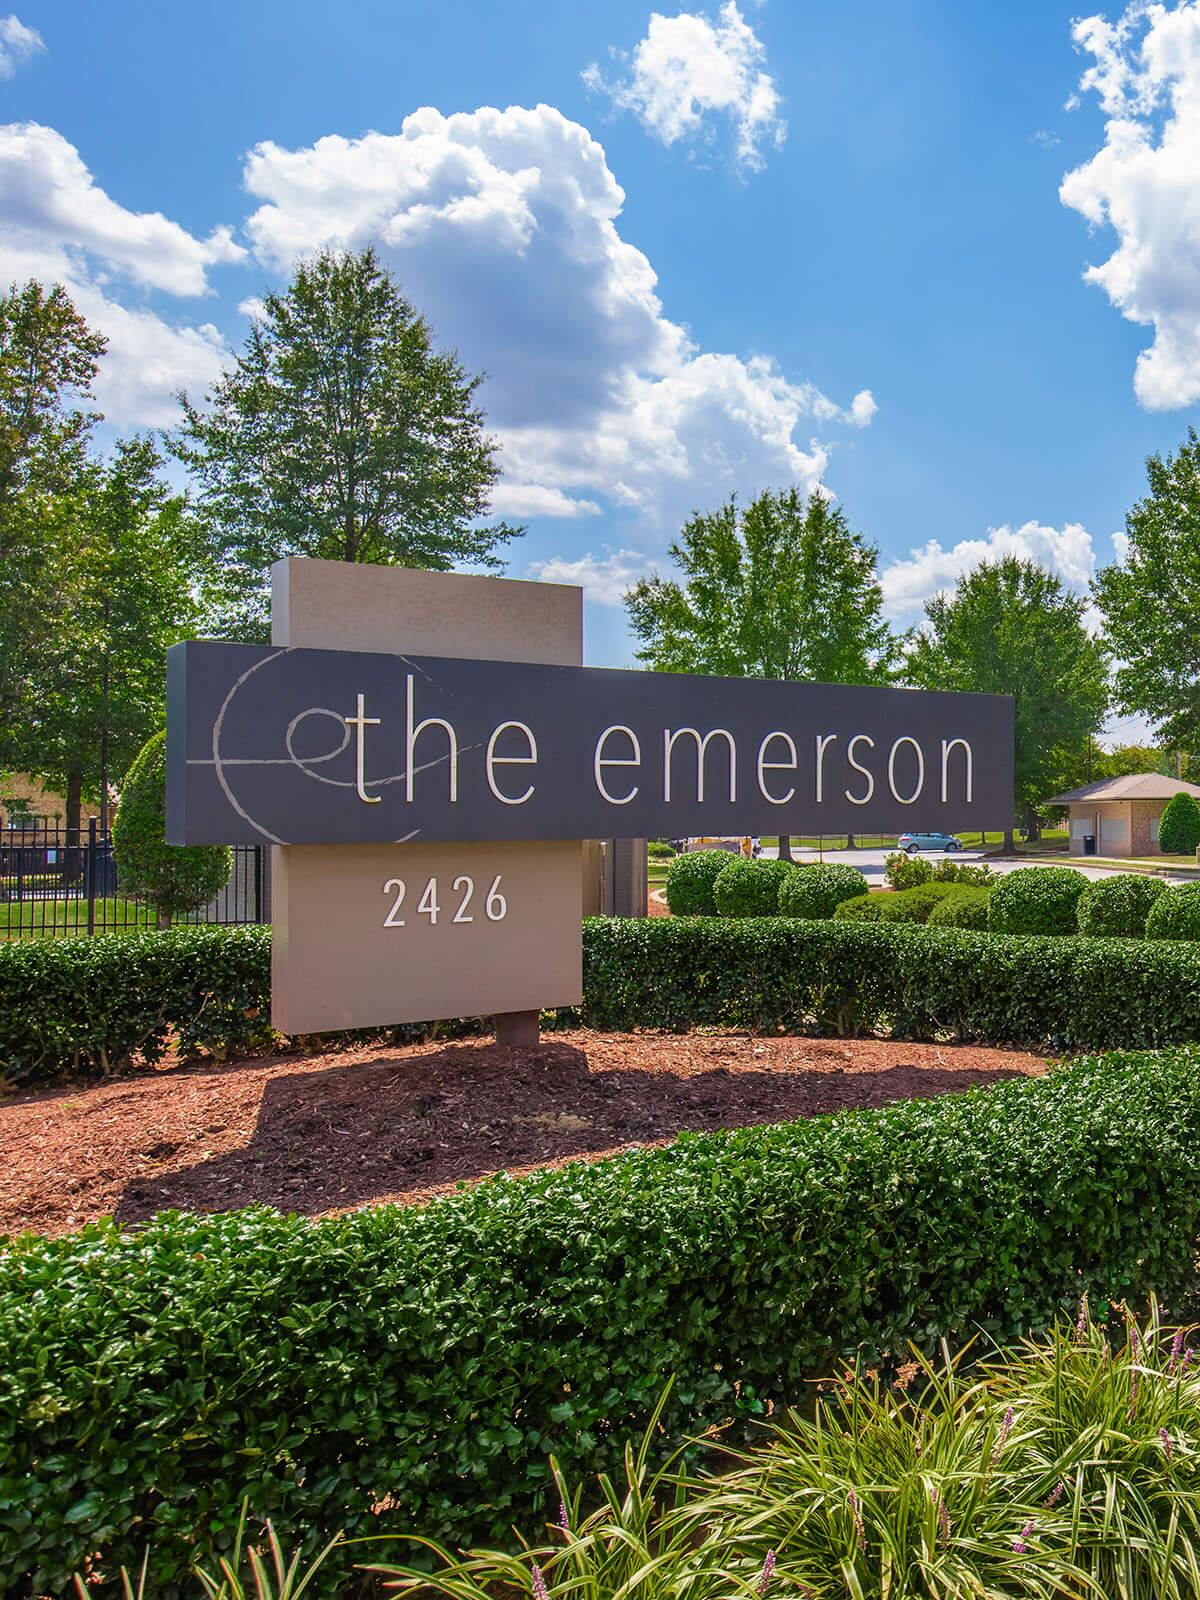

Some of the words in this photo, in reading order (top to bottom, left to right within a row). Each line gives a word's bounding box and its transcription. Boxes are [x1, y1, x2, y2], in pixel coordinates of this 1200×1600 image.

[345, 674, 538, 805] the
[593, 724, 975, 805] emerson
[382, 875, 508, 928] 2426
